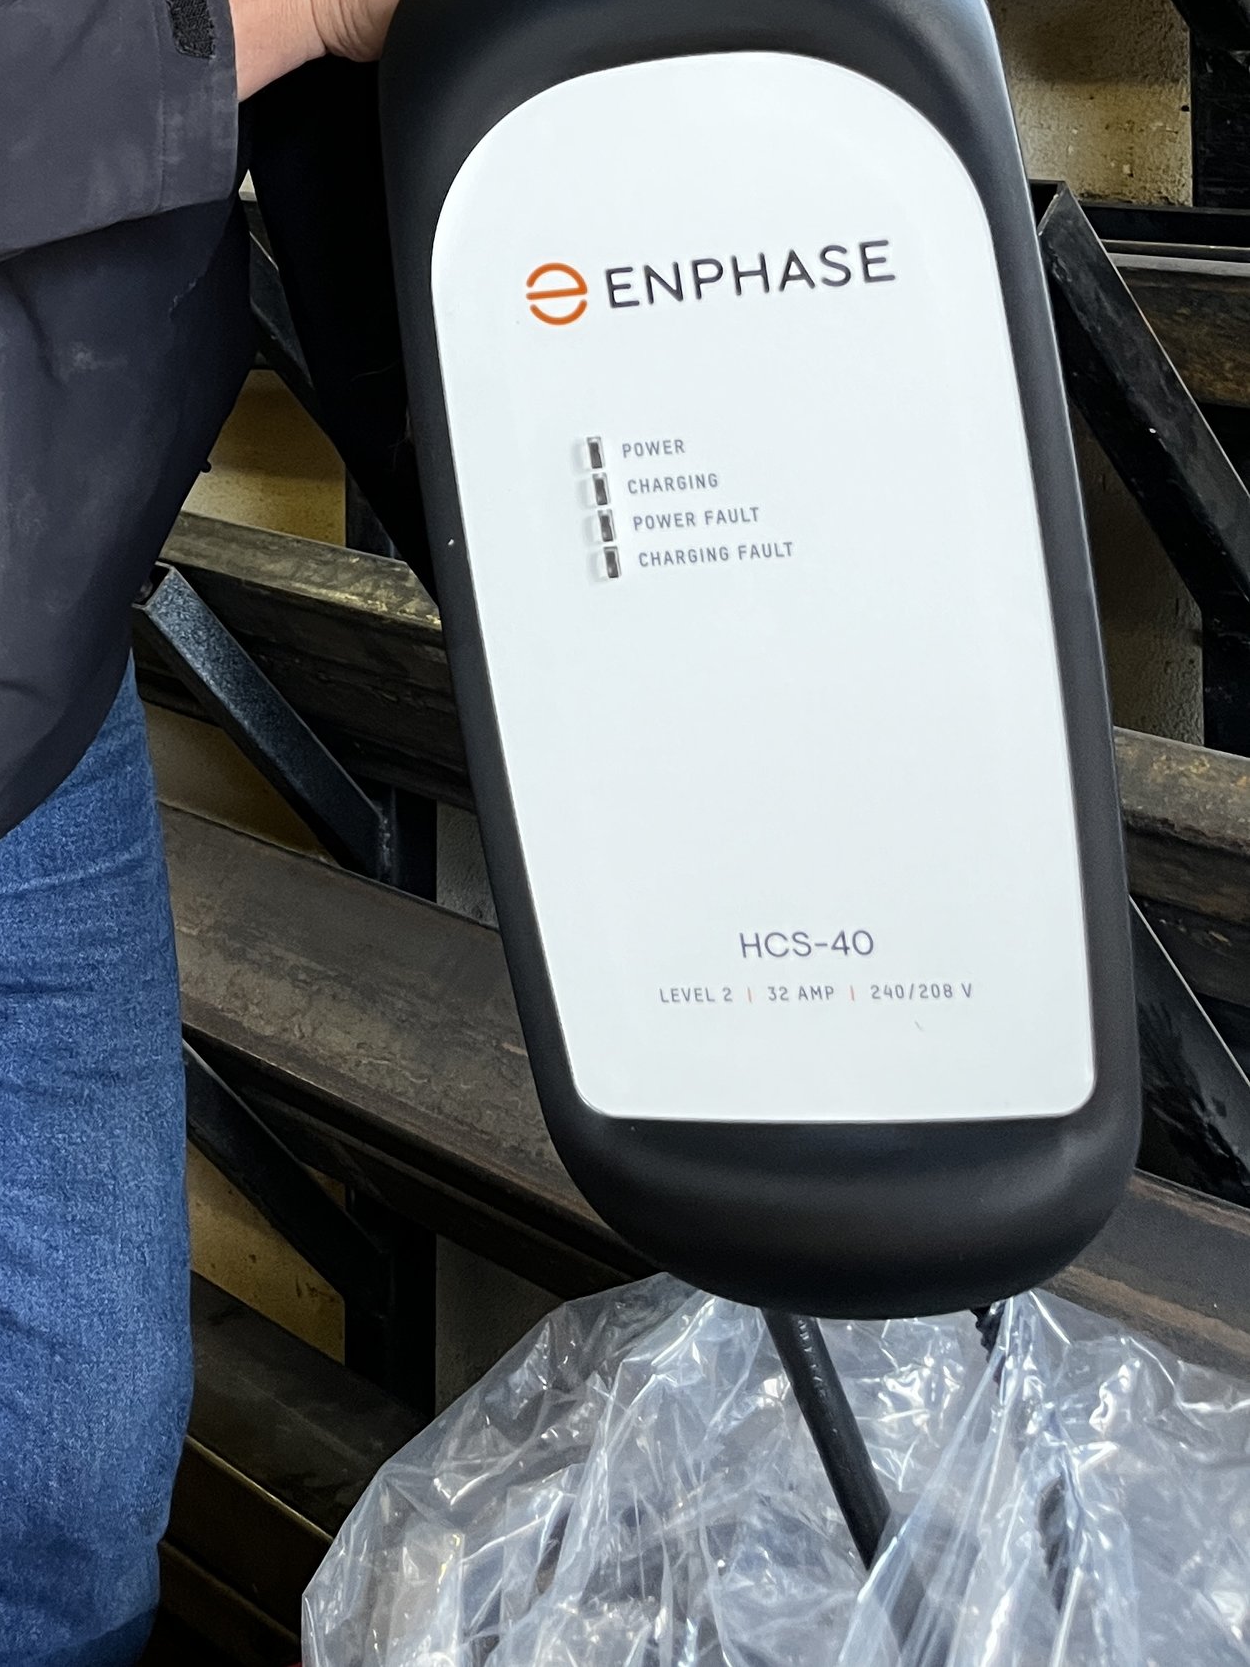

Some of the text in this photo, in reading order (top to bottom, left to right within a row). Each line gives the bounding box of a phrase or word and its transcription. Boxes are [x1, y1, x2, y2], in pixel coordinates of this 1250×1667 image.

[606, 239, 896, 309] ENPHASE
[621, 439, 685, 459] POWER
[628, 473, 719, 495] CHARGING
[632, 506, 760, 531] POWER FAULT
[638, 541, 794, 568] CHARGING FAULT
[739, 929, 874, 959] HCS-40
[659, 983, 973, 1003] LEVEL 2 32 AMP 240/208 V
